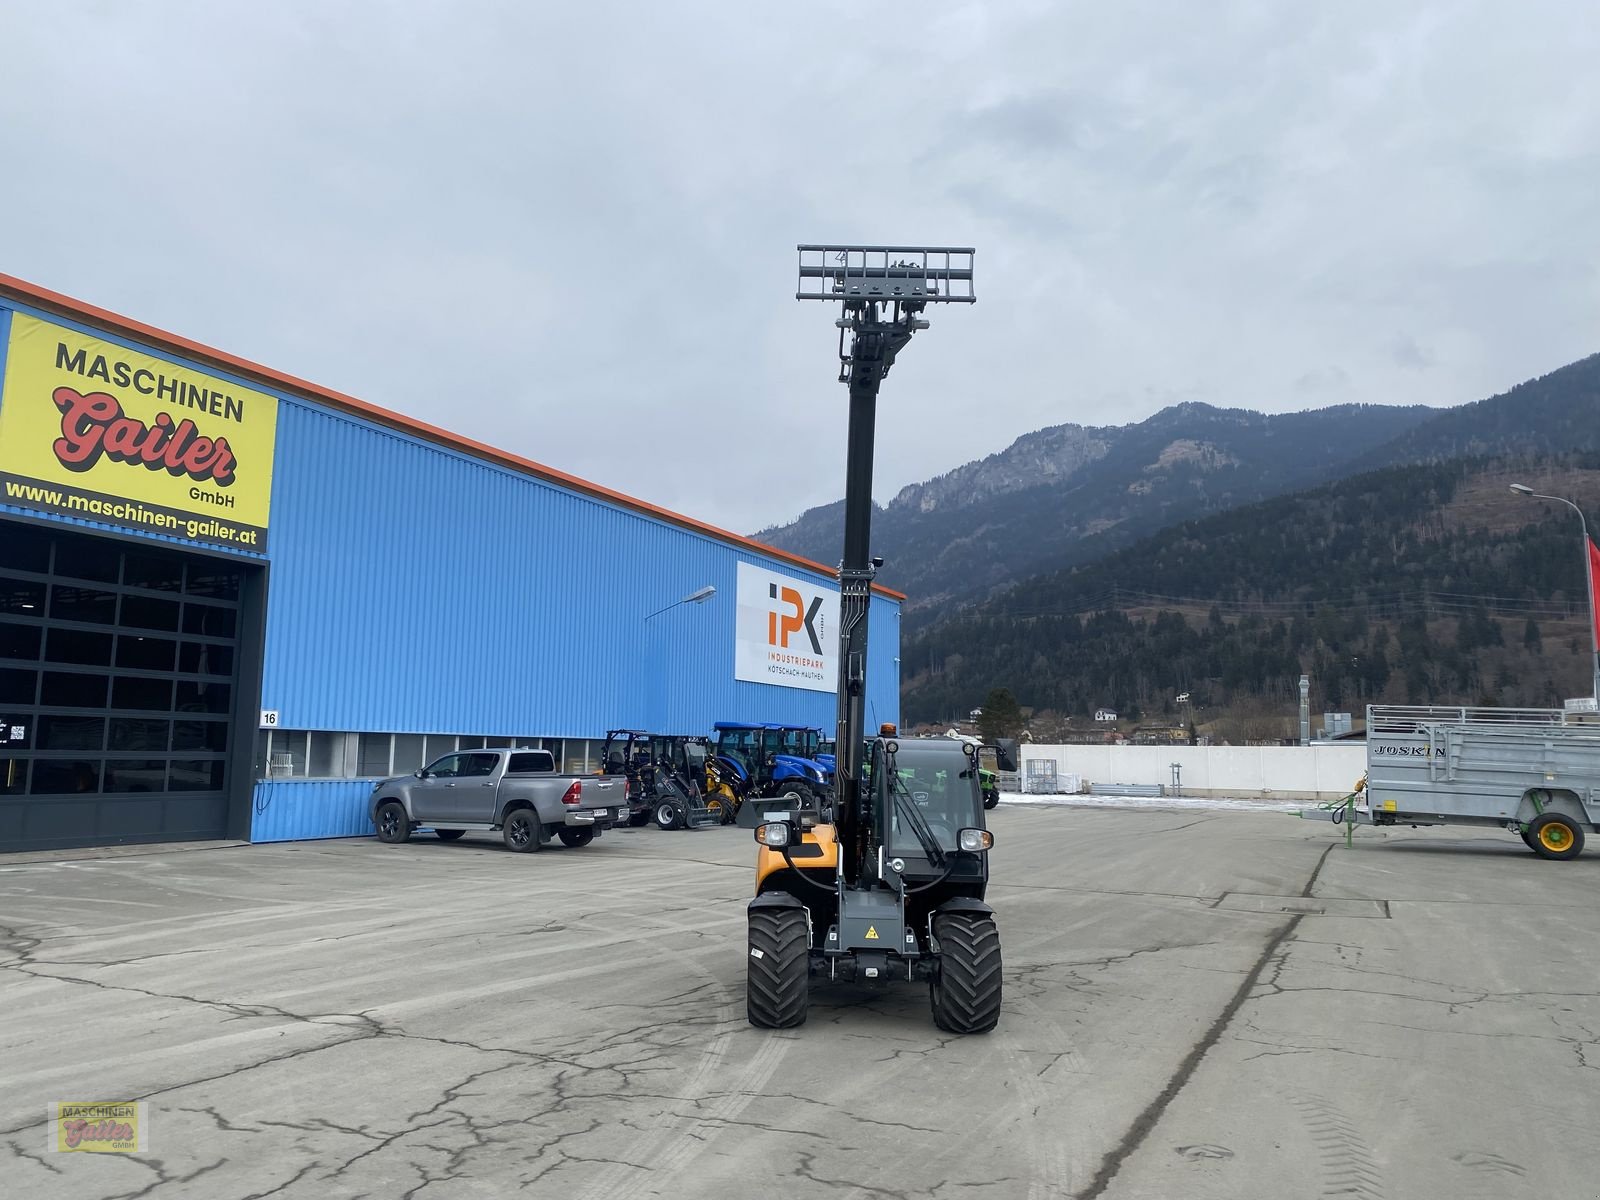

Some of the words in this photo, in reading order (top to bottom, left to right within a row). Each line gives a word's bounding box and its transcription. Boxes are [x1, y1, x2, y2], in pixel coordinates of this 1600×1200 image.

[55, 342, 244, 423] MASCHINEN
[52, 386, 237, 487] Gailer
[188, 487, 235, 508] GmbH
[5, 481, 257, 545] www.maschinen-gailer.at
[768, 651, 824, 670] INDUSTRIEPARK
[264, 713, 276, 724] 16
[1374, 745, 1447, 759] JOSKIN
